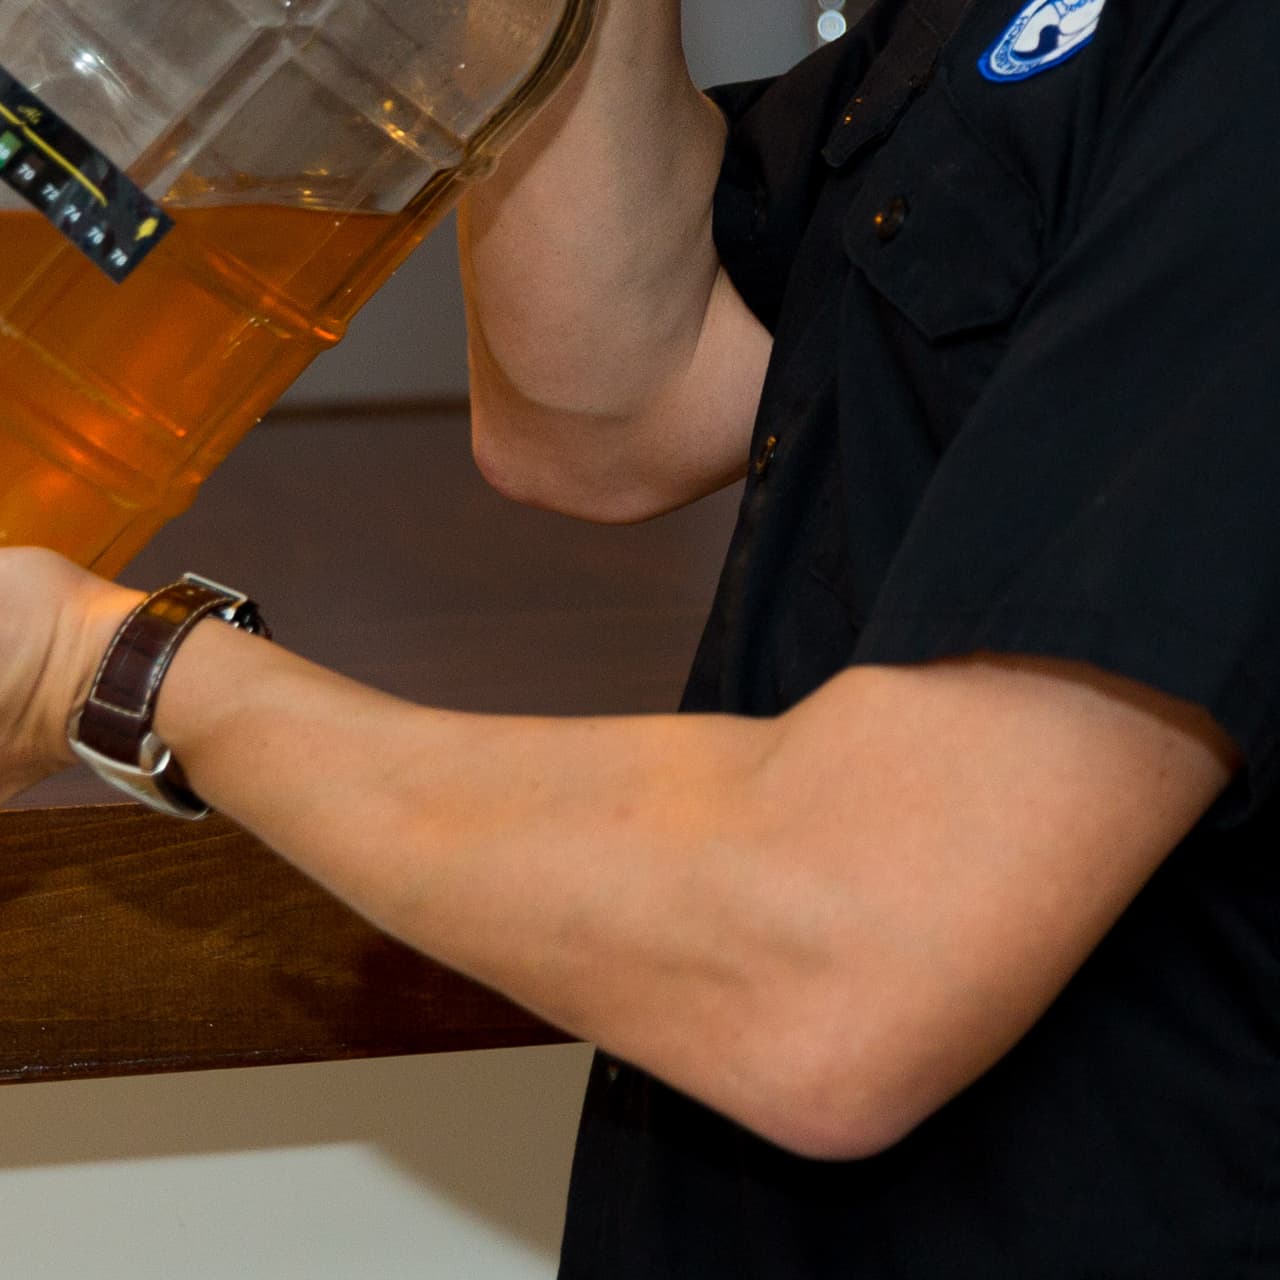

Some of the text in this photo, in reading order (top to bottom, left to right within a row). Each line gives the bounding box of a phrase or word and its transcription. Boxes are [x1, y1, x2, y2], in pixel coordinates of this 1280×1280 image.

[18, 163, 36, 181] 70
[41, 183, 61, 201] 72
[64, 204, 82, 222] 74
[87, 226, 105, 245] 76
[110, 248, 128, 267] 78
